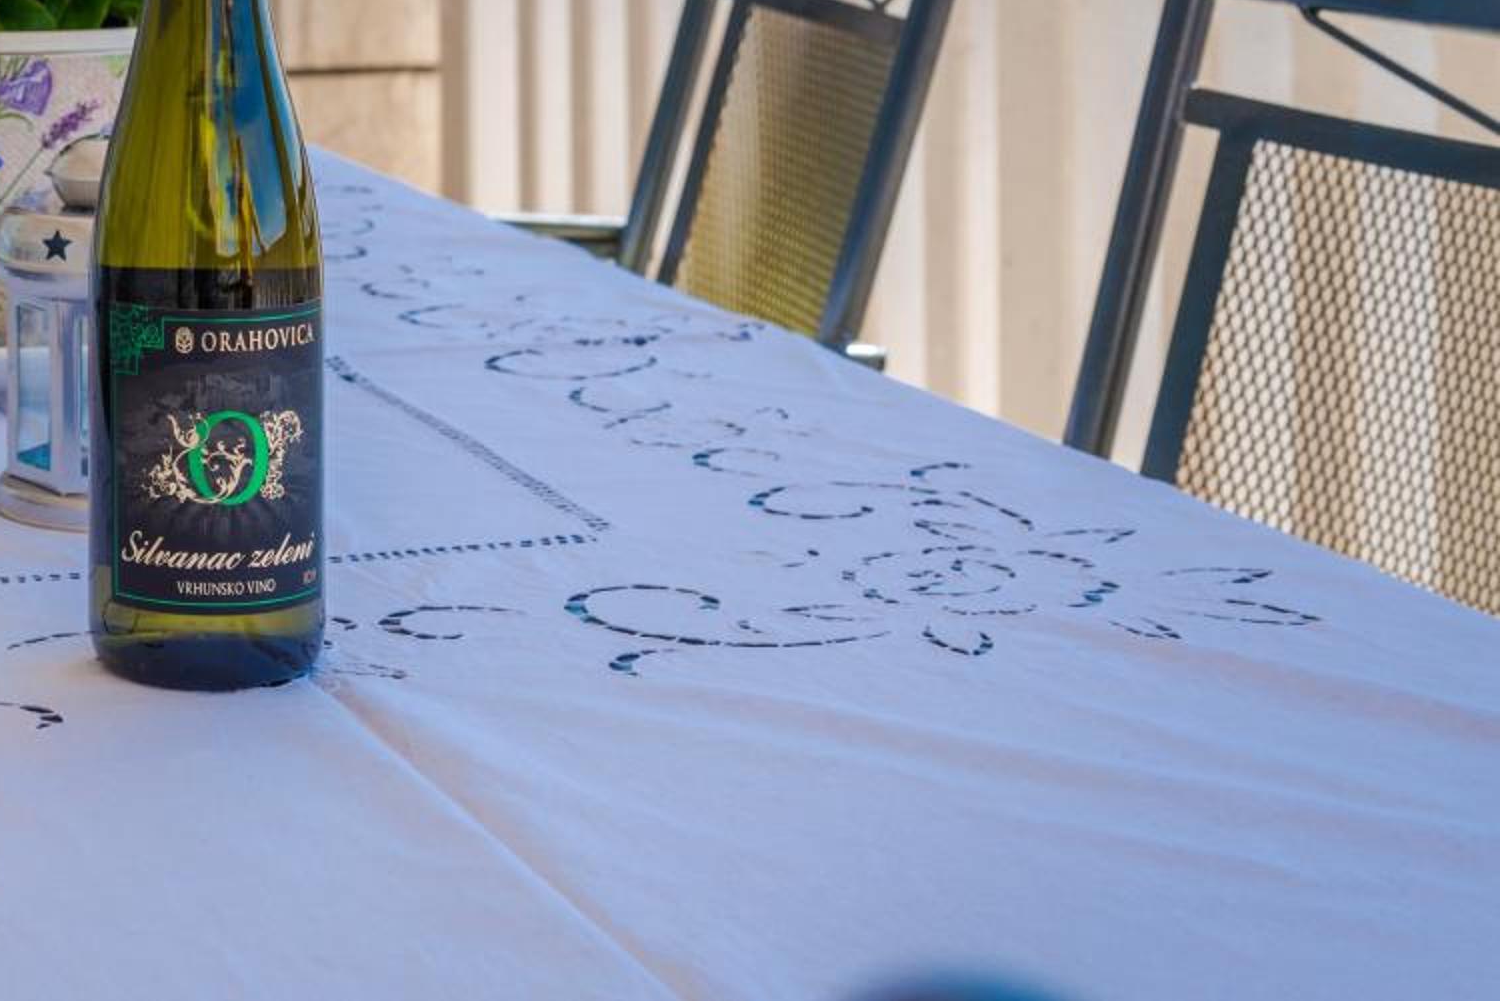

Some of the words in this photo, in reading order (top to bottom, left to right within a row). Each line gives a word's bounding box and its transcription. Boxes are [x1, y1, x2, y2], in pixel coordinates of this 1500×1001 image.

[201, 322, 315, 353] ORAHOVICA
[121, 530, 244, 571] Silvanac
[249, 532, 316, 569] zeleni
[176, 579, 245, 596] VRHUNSKO
[249, 578, 277, 594] VINO
